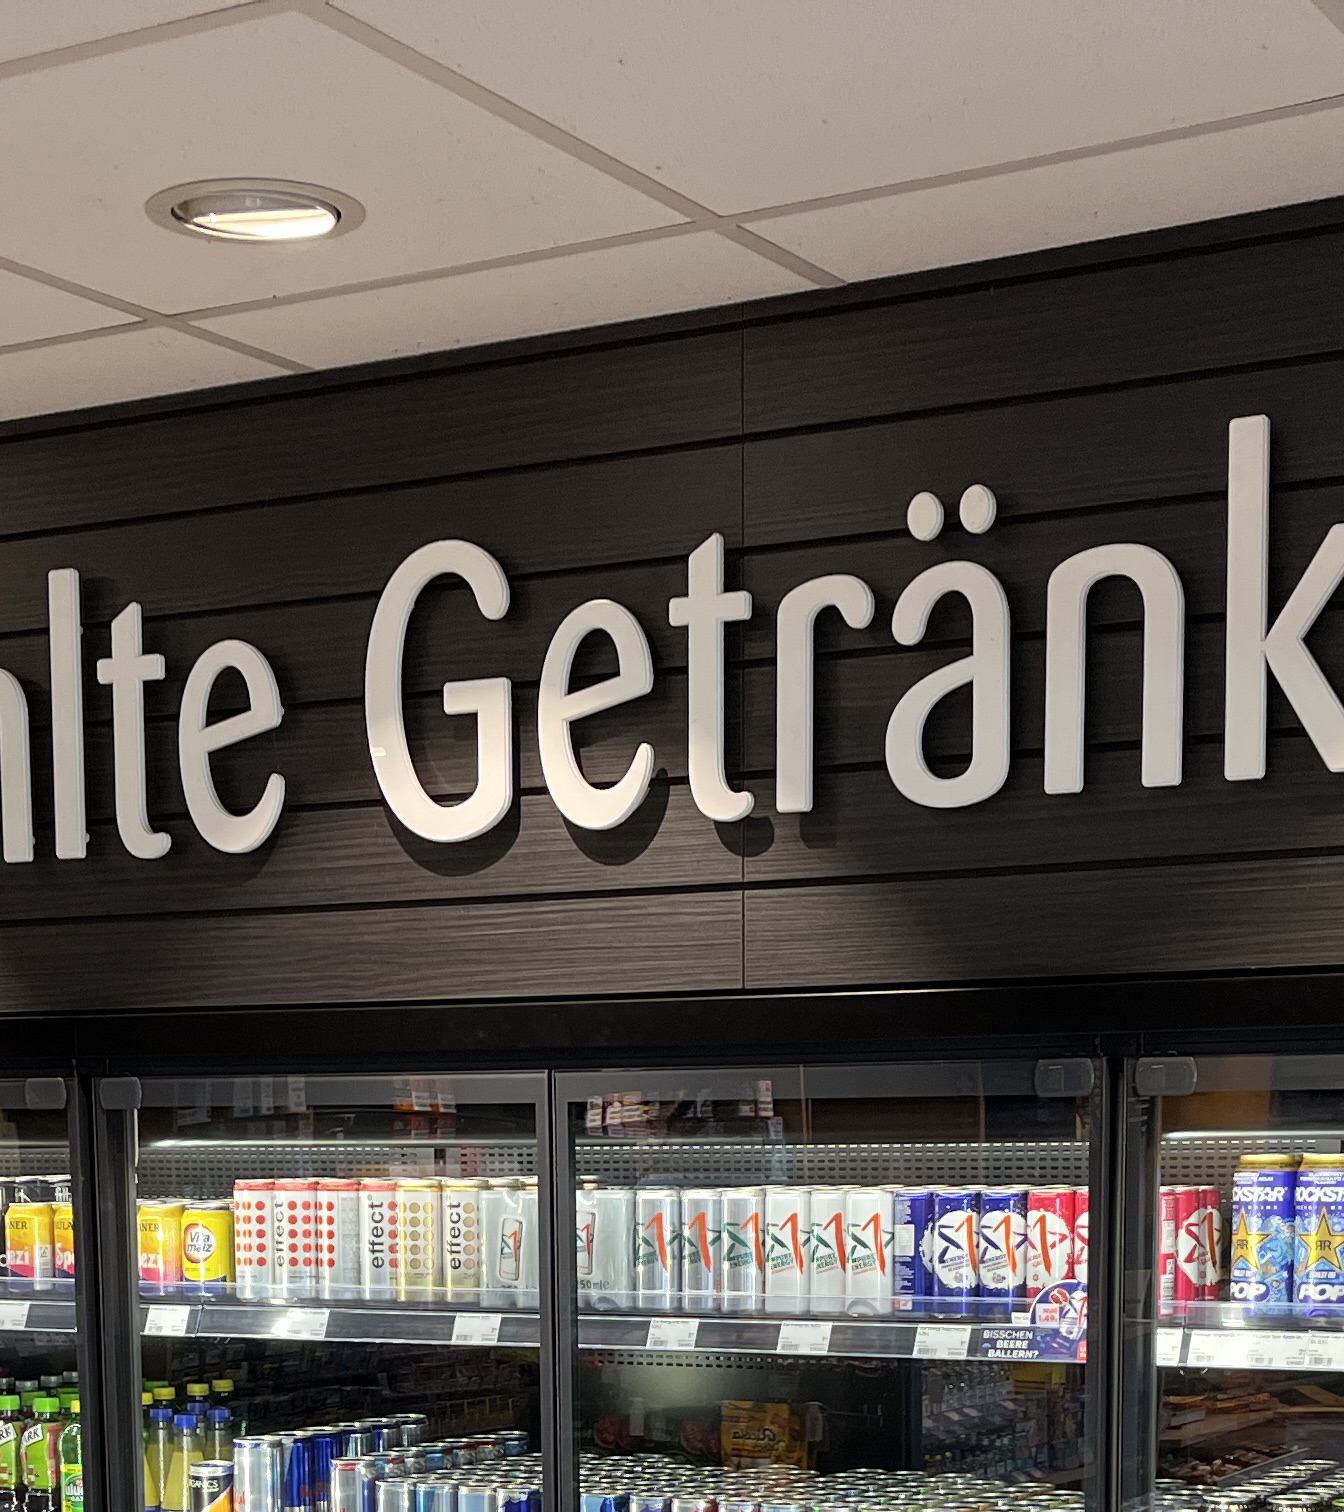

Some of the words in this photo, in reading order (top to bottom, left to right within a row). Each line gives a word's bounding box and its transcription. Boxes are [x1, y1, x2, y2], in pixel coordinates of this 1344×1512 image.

[367, 1201, 385, 1270] effect
[447, 1201, 462, 1270] effect
[982, 1329, 1033, 1340] BISSCHEN
[996, 1340, 1029, 1349] BEERE
[987, 1350, 1039, 1359] BALLERN?
